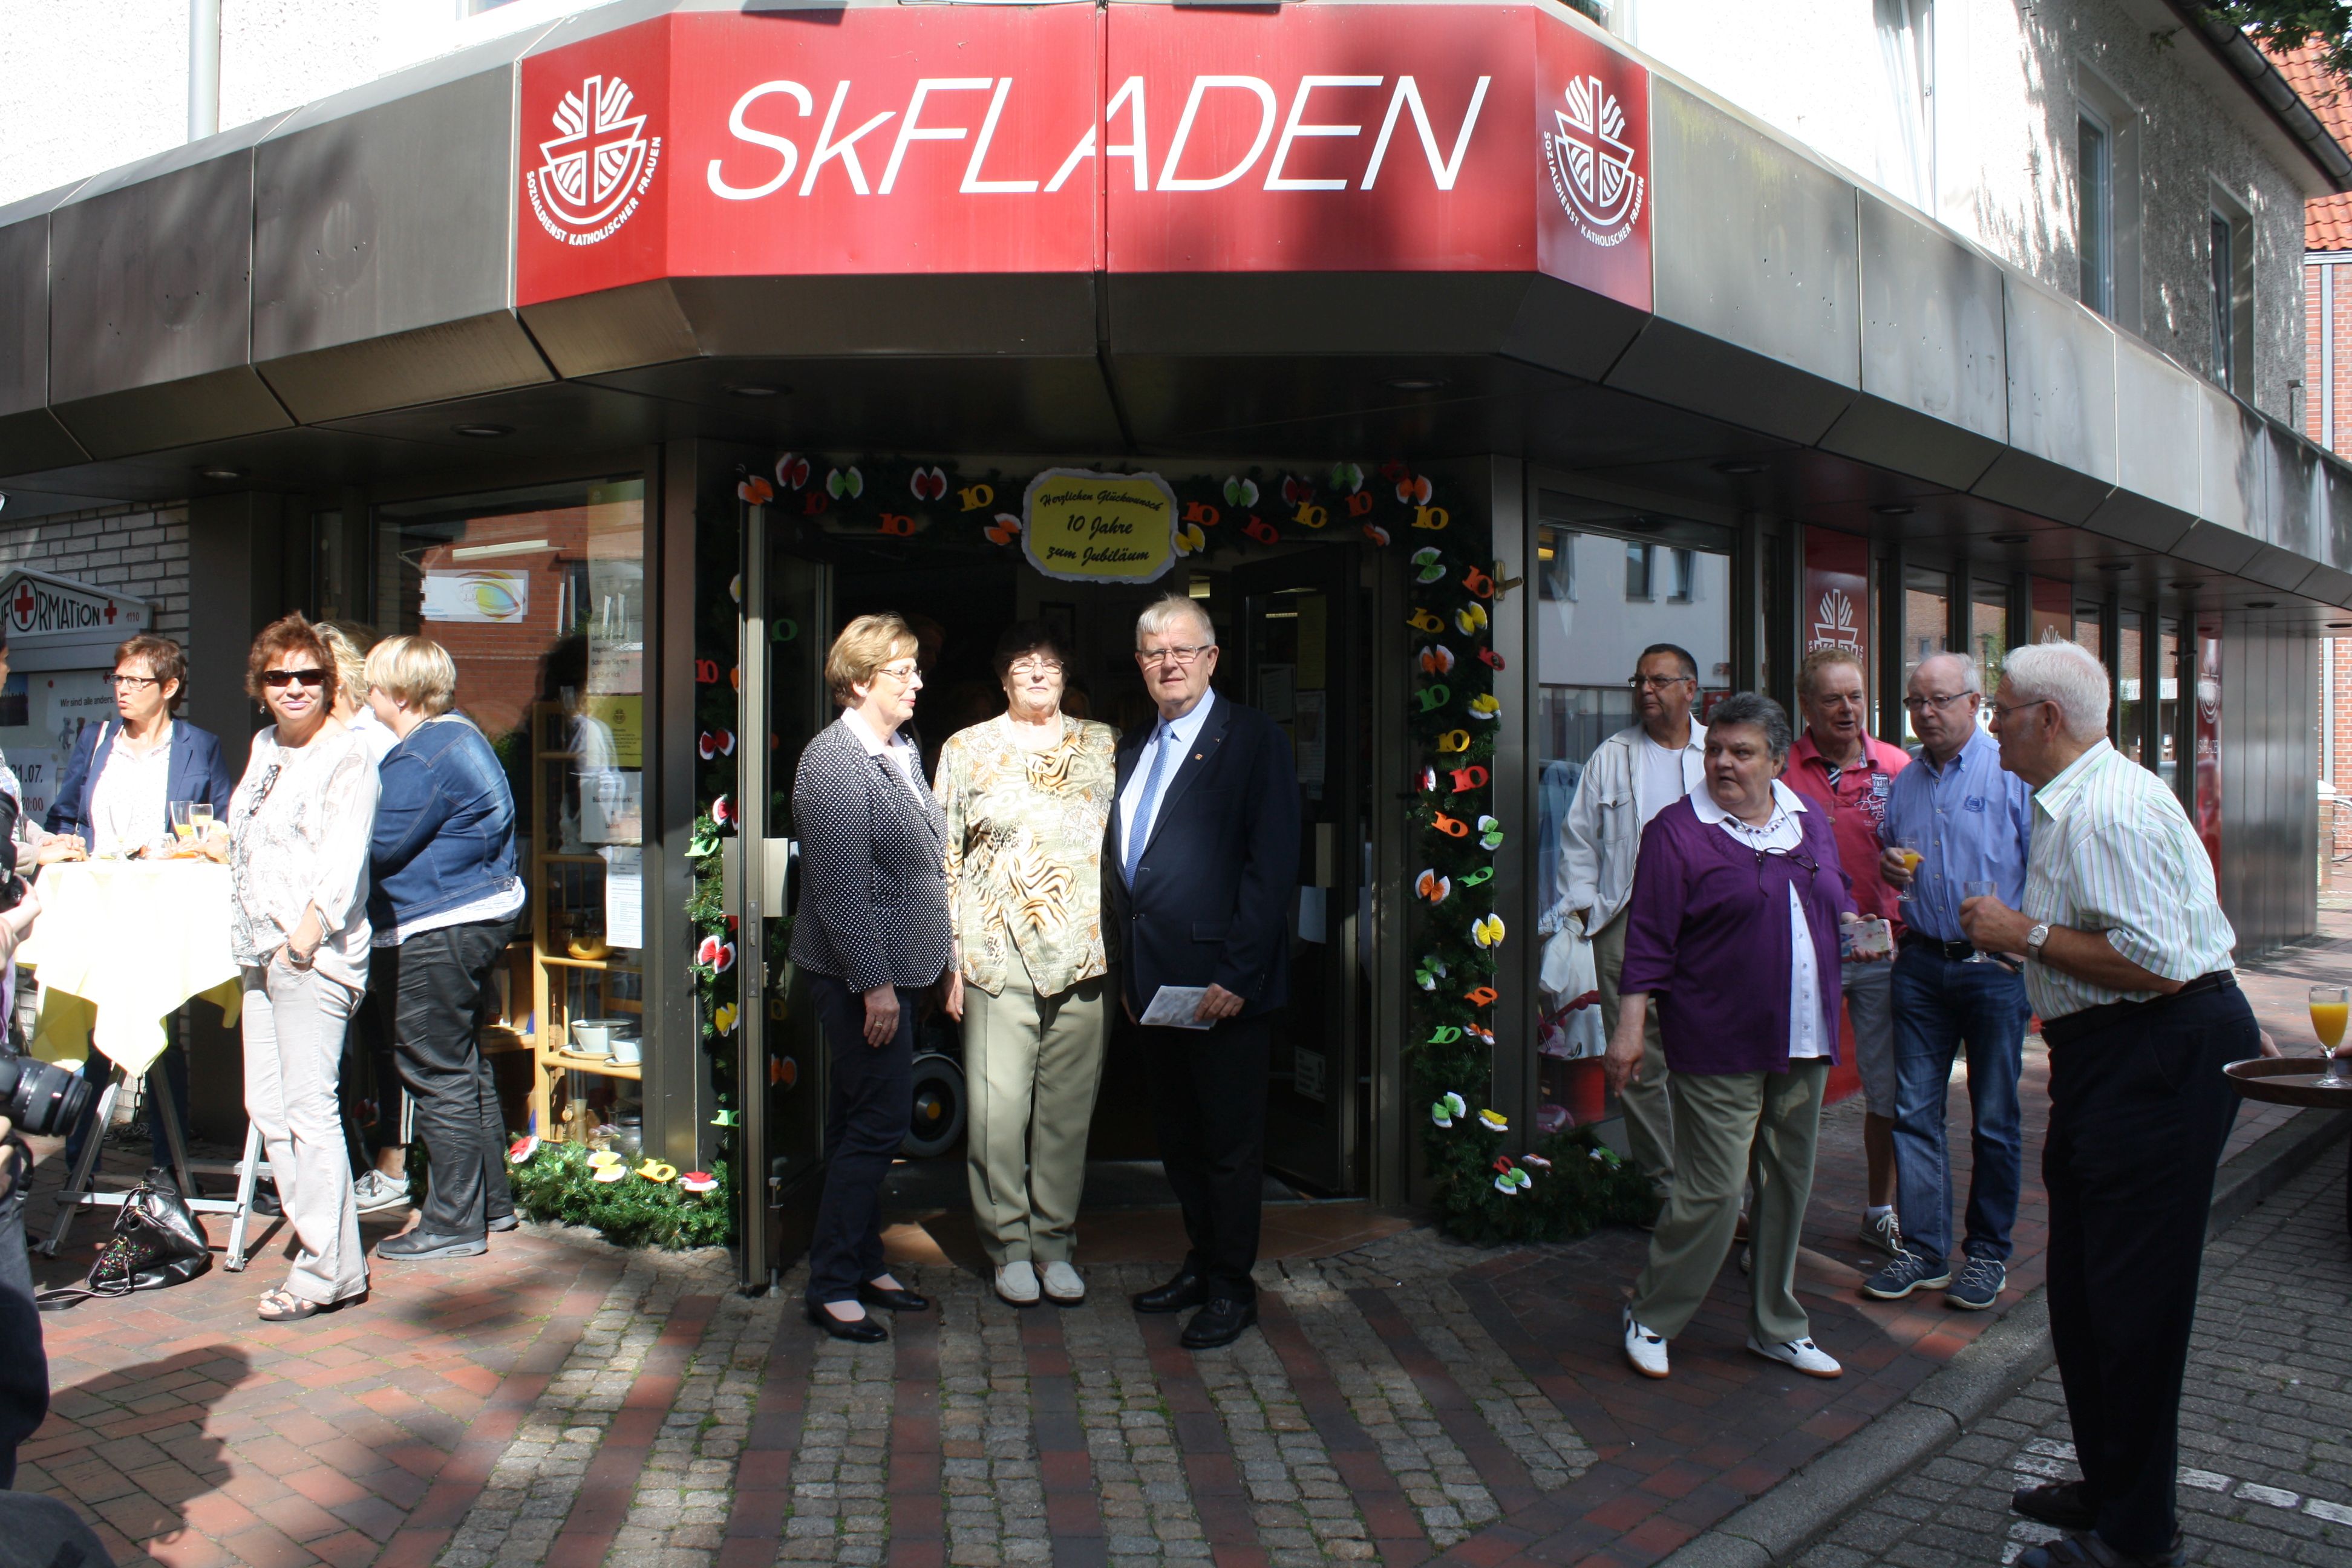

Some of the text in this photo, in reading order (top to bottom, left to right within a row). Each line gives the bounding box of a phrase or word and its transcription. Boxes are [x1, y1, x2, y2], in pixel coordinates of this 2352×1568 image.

[526, 136, 662, 246] SOZIALDIENST KATHOLISCHER FRAUEN
[1543, 130, 1645, 247] SOZIALDIENST KATHOLISCHER FRAUEN
[958, 485, 993, 511] 10
[1040, 489, 1164, 511] Herzlichen Glückwunsch
[1345, 491, 1373, 517] 10
[878, 514, 915, 536] 10
[1183, 501, 1219, 526] 10
[1292, 501, 1328, 528] 10
[1411, 506, 1449, 530] 10
[1067, 514, 1133, 540] 10 Jahre
[1242, 514, 1279, 544] 10
[1046, 546, 1150, 567] zum Jubiläum
[1463, 566, 1494, 598] 10
[771, 619, 798, 641] 0
[1406, 607, 1445, 633] 10
[83, 697, 93, 705] alle
[94, 696, 114, 704] anders.
[1415, 684, 1450, 713] 10
[1436, 730, 1470, 753] 10
[1449, 766, 1489, 792] 10
[1431, 811, 1468, 837] 10
[1457, 866, 1494, 887] 10
[1464, 987, 1498, 1007] 10
[1428, 1026, 1461, 1044] 10
[635, 1158, 676, 1182] 10
